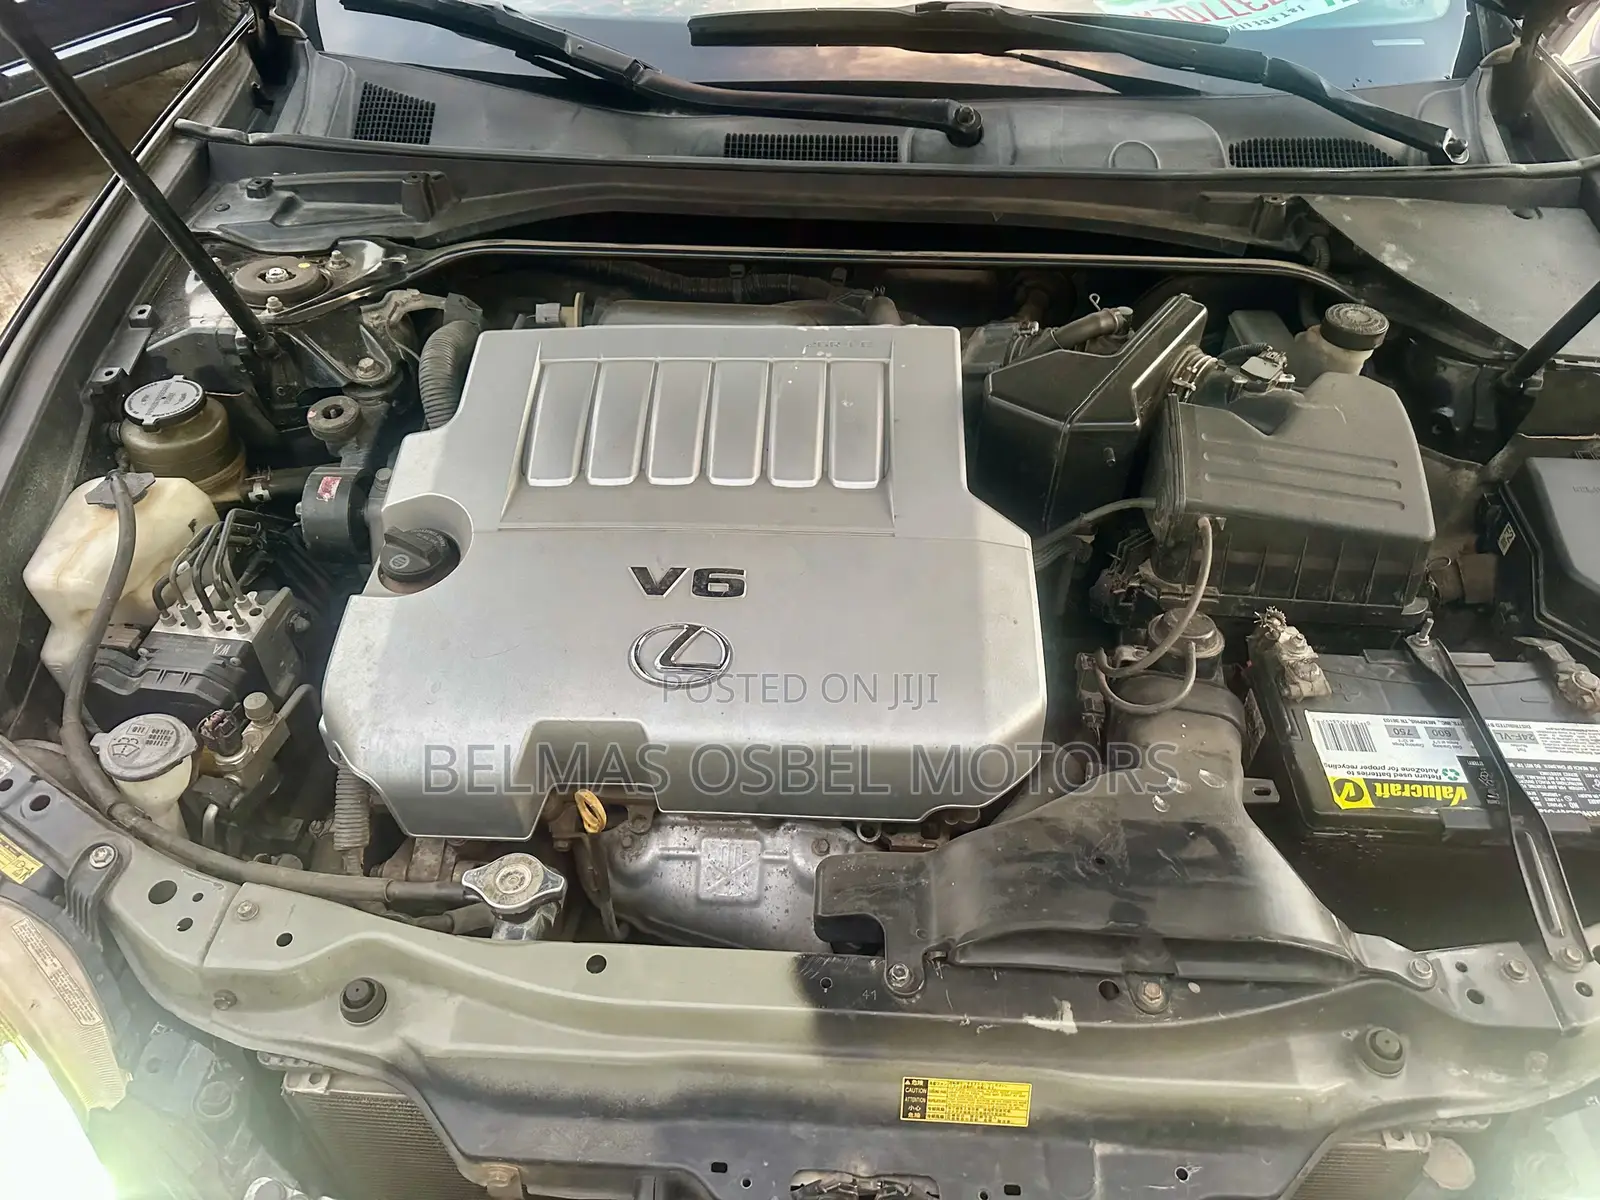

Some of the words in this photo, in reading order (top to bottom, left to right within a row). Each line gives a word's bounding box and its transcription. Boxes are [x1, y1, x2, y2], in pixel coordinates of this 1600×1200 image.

[628, 566, 747, 599] V6
[1408, 718, 1437, 726] MEMPHIS,
[1393, 728, 1413, 737] 750
[1431, 729, 1452, 738] 600
[1495, 732, 1535, 741] 24F-VL
[1323, 762, 1358, 771] recycling
[1359, 763, 1386, 771] proper
[1400, 766, 1439, 774] AutoZone
[1356, 770, 1392, 778] batteries
[1373, 781, 1468, 807] Valucraft
